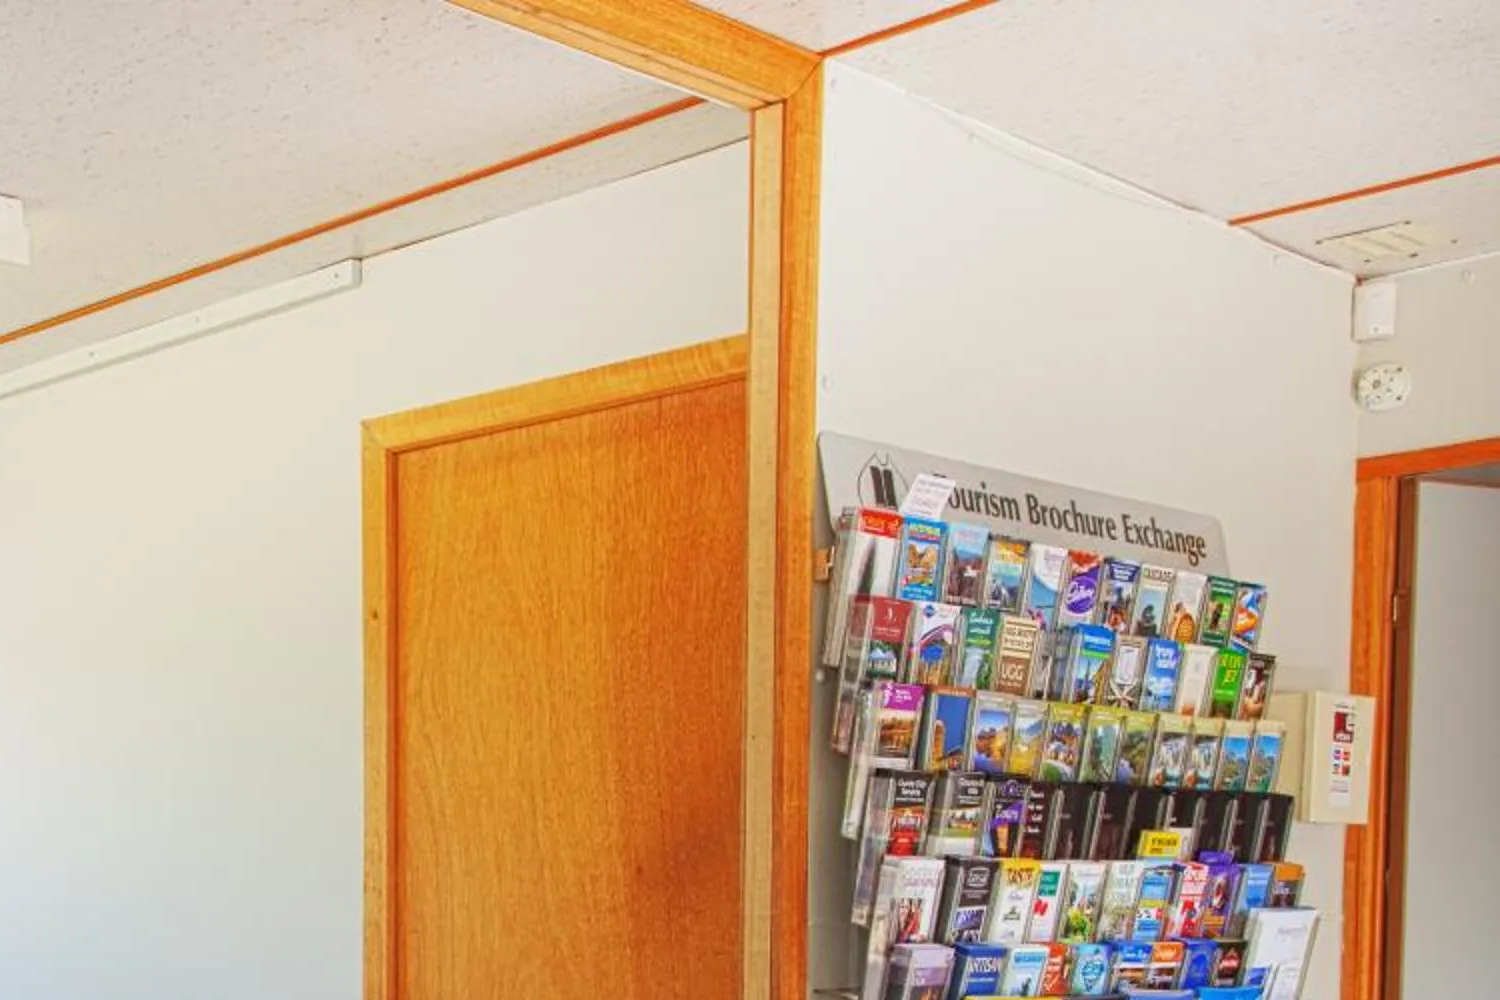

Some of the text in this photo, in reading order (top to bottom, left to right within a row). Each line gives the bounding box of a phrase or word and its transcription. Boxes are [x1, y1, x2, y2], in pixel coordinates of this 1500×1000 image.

[933, 472, 1021, 521] ourism
[1025, 492, 1116, 543] Brochure
[1123, 516, 1207, 567] Exchange
